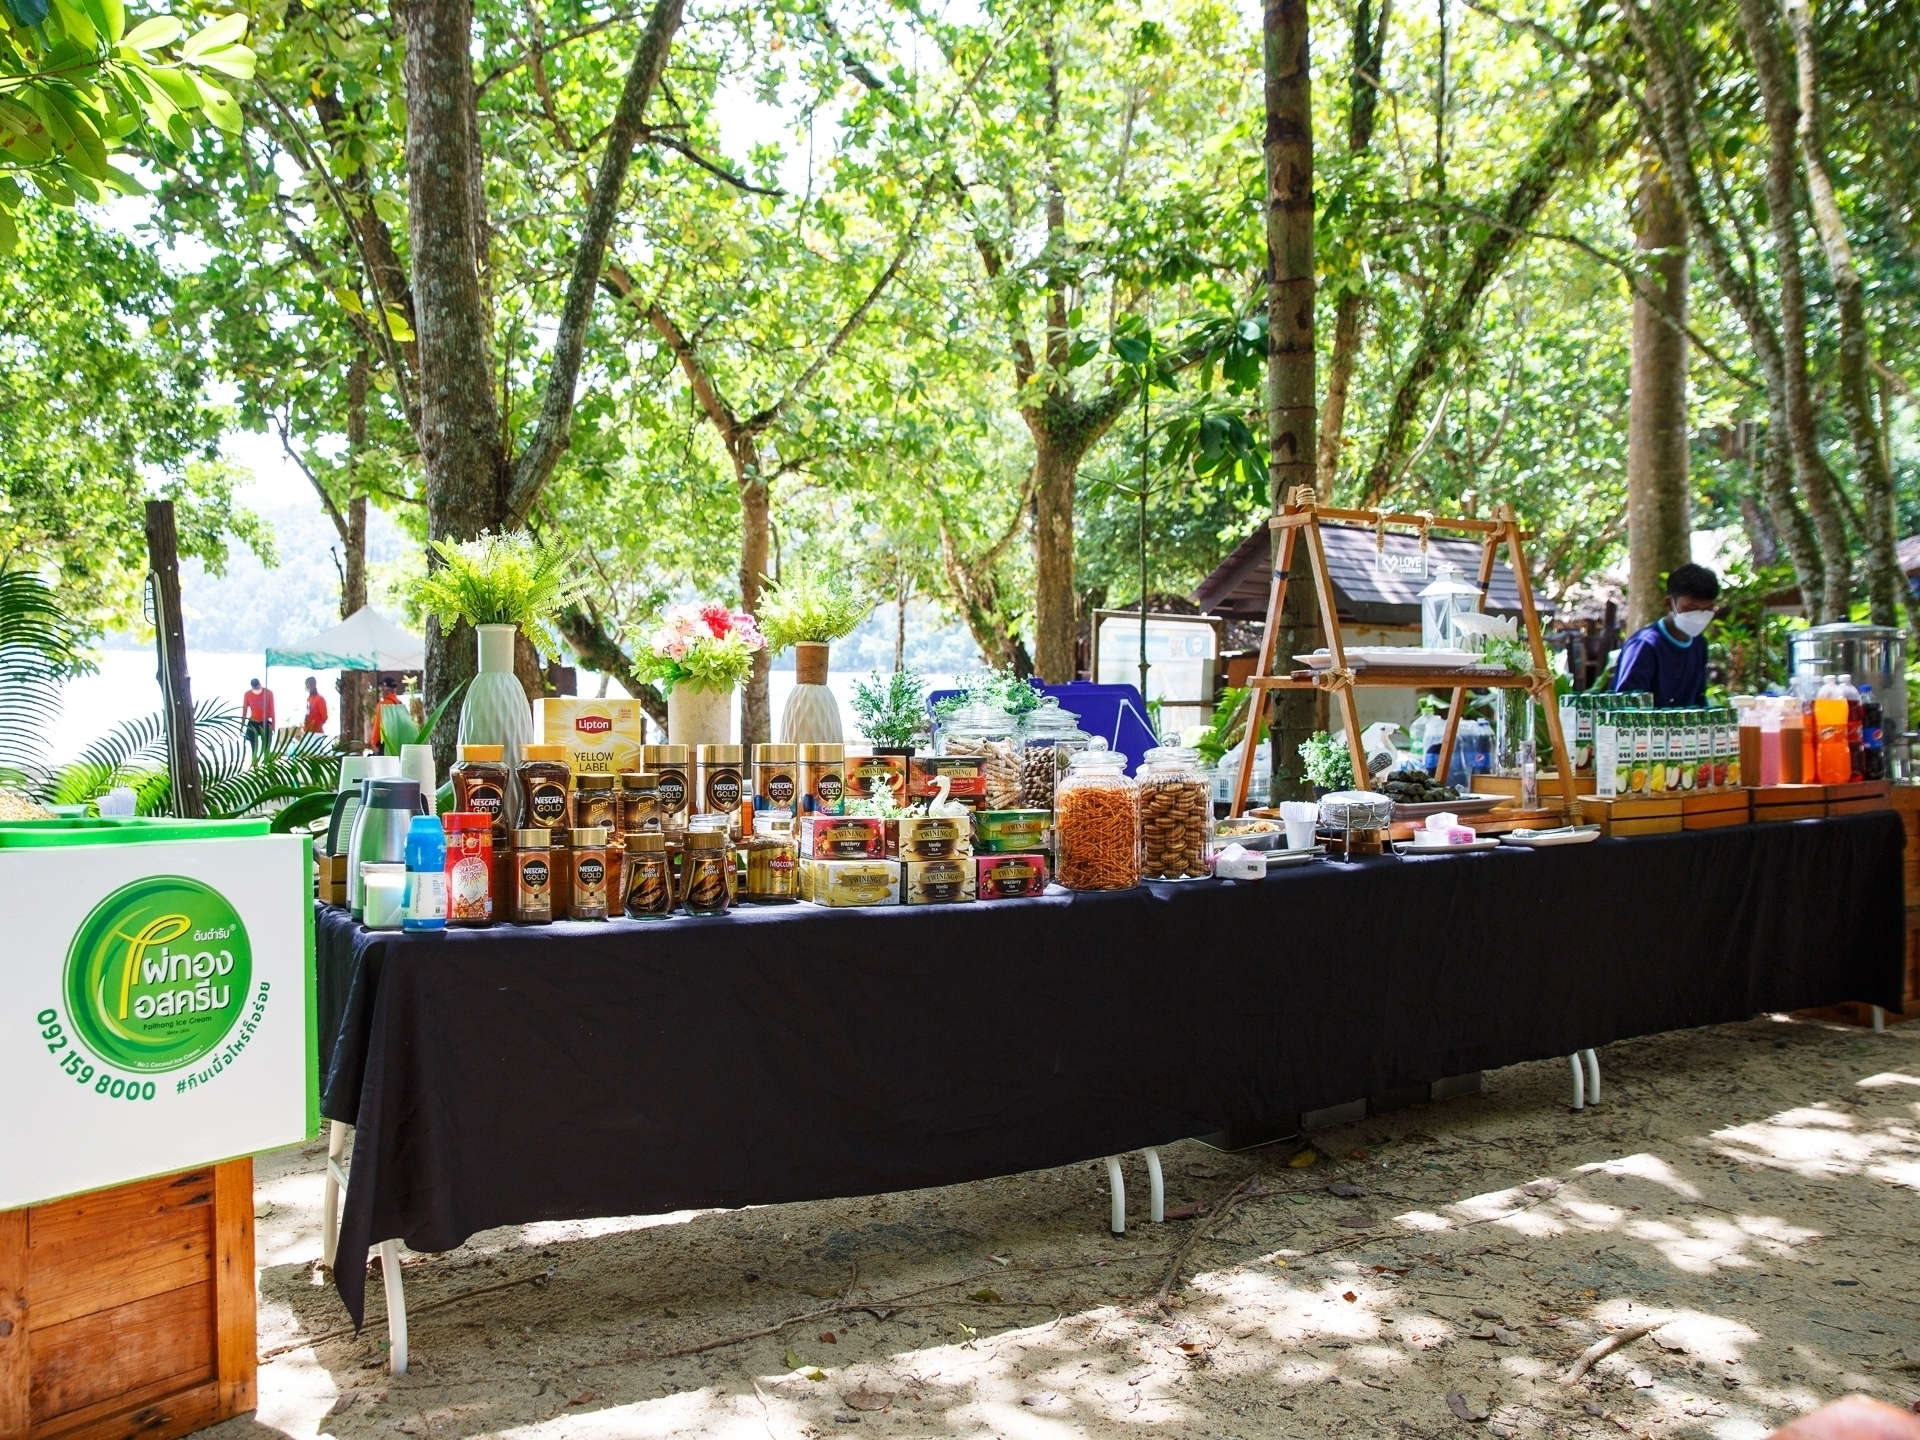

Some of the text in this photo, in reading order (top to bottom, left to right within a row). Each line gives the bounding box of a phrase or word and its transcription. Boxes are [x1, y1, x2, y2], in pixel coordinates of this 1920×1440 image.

[1400, 556, 1422, 568] LOVE
[579, 720, 609, 730] Lipton
[574, 752, 614, 761] YELLOW
[580, 763, 610, 772] LABEL
[538, 804, 562, 812] GOLD
[1006, 822, 1036, 831] TWININGS
[834, 830, 867, 839] TWININGS
[919, 830, 953, 838] TWININGS
[459, 863, 483, 873] SEASONS
[997, 867, 1029, 877] TWININGS
[850, 875, 882, 884] TWININGS
[926, 872, 958, 882] TWININGS
[143, 1021, 174, 1030] Paithong
[189, 1016, 212, 1024] Cream
[37, 1008, 156, 1101] 092 159 8000
